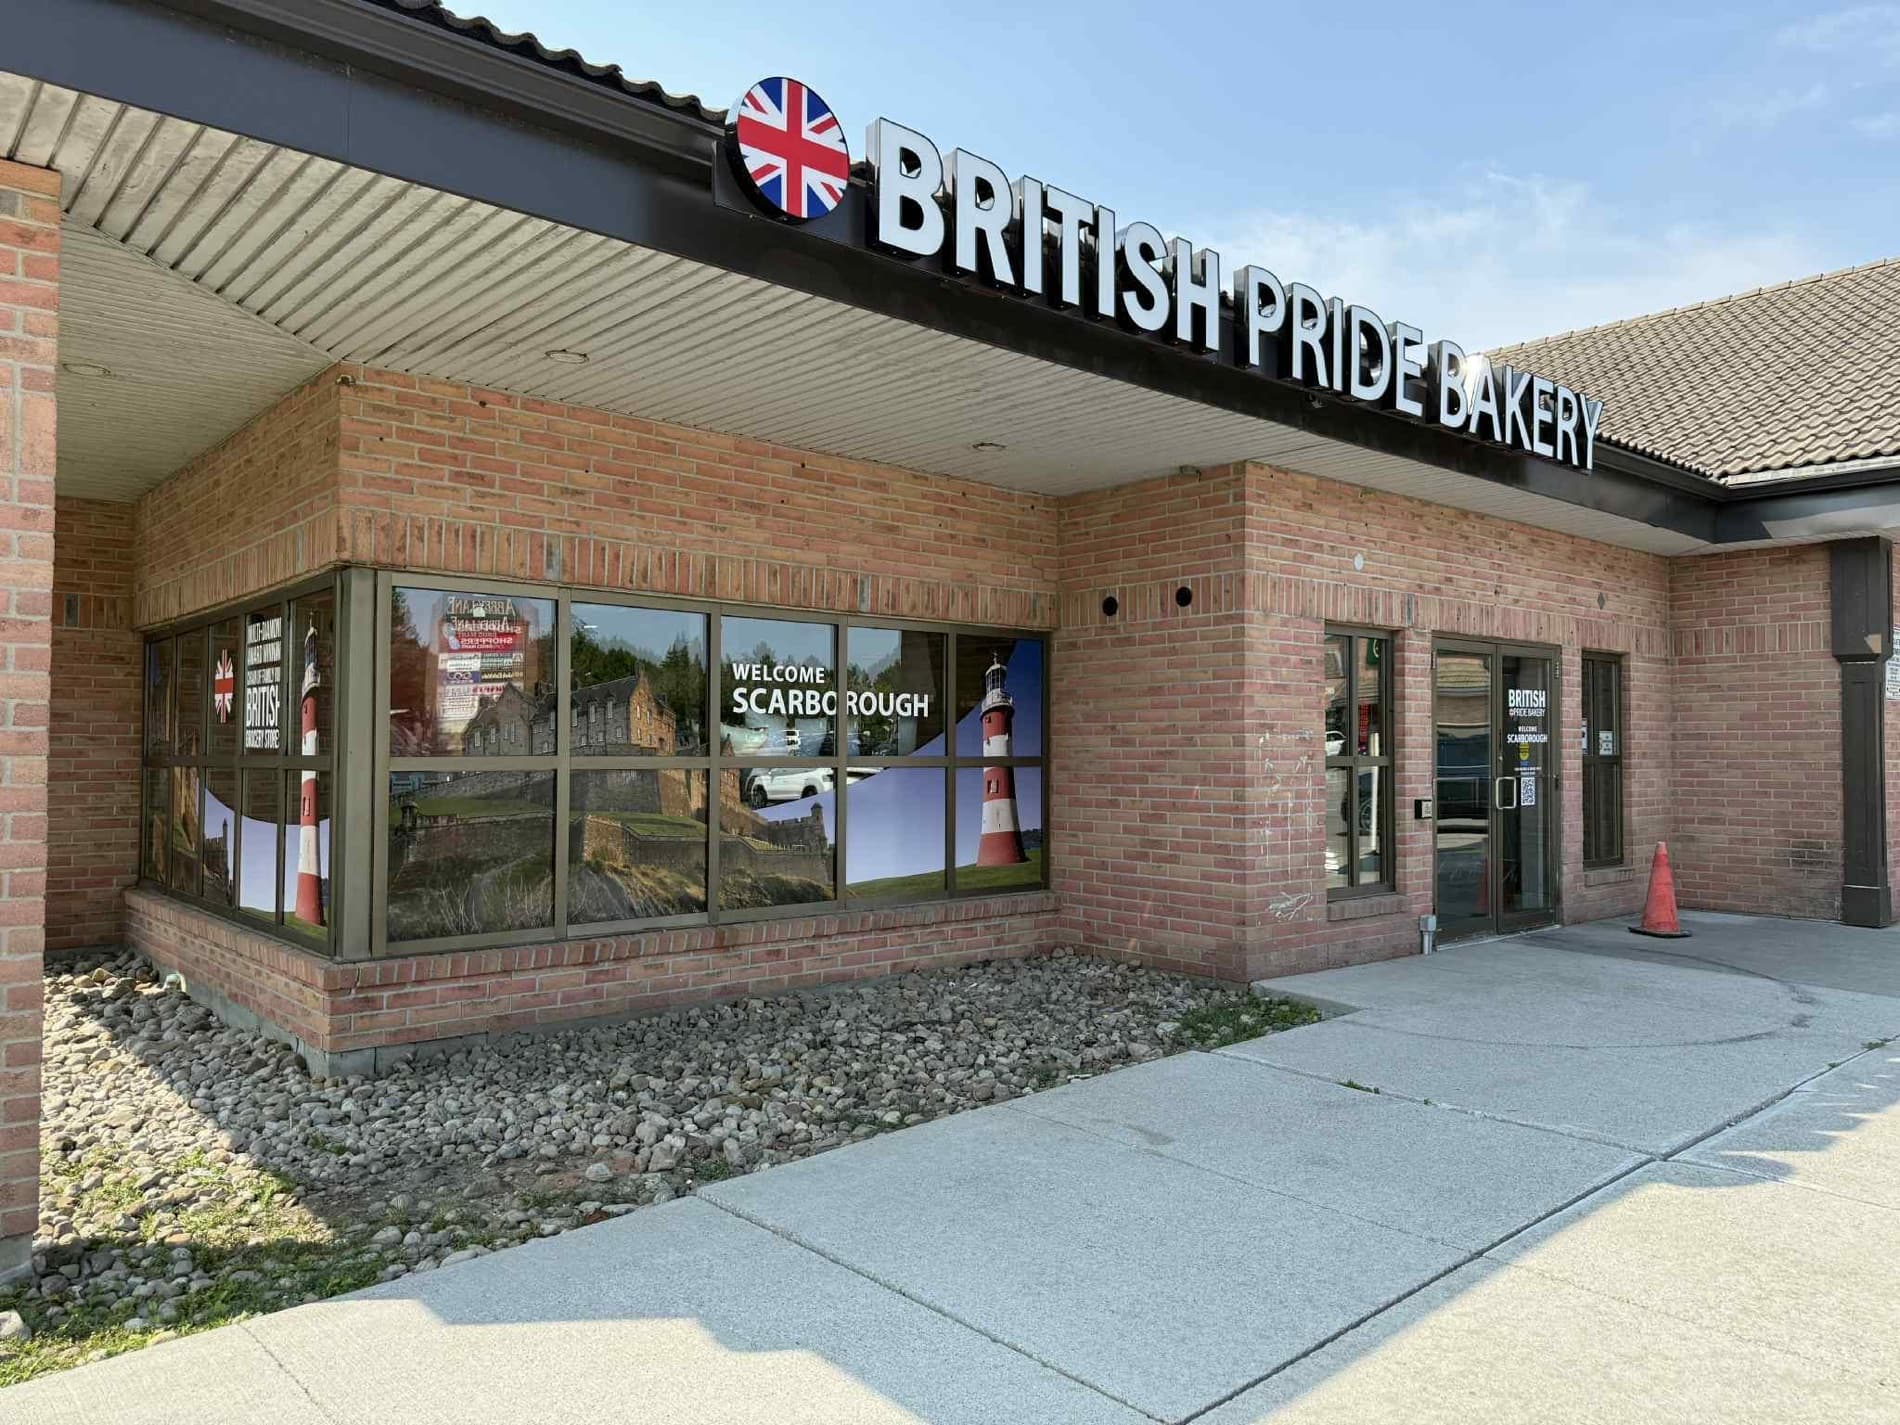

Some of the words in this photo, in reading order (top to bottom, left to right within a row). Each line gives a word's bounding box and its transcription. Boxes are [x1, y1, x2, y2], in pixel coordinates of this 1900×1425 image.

[877, 116, 1221, 351] BRITISH
[1246, 264, 1424, 417] PRIDE
[1438, 339, 1604, 471] BAKERY
[732, 663, 825, 683] WELCOME
[732, 687, 929, 718] SCARBOROUGH
[1508, 689, 1546, 708] BRITISH
[1507, 733, 1548, 744] SCARBOROUGH
